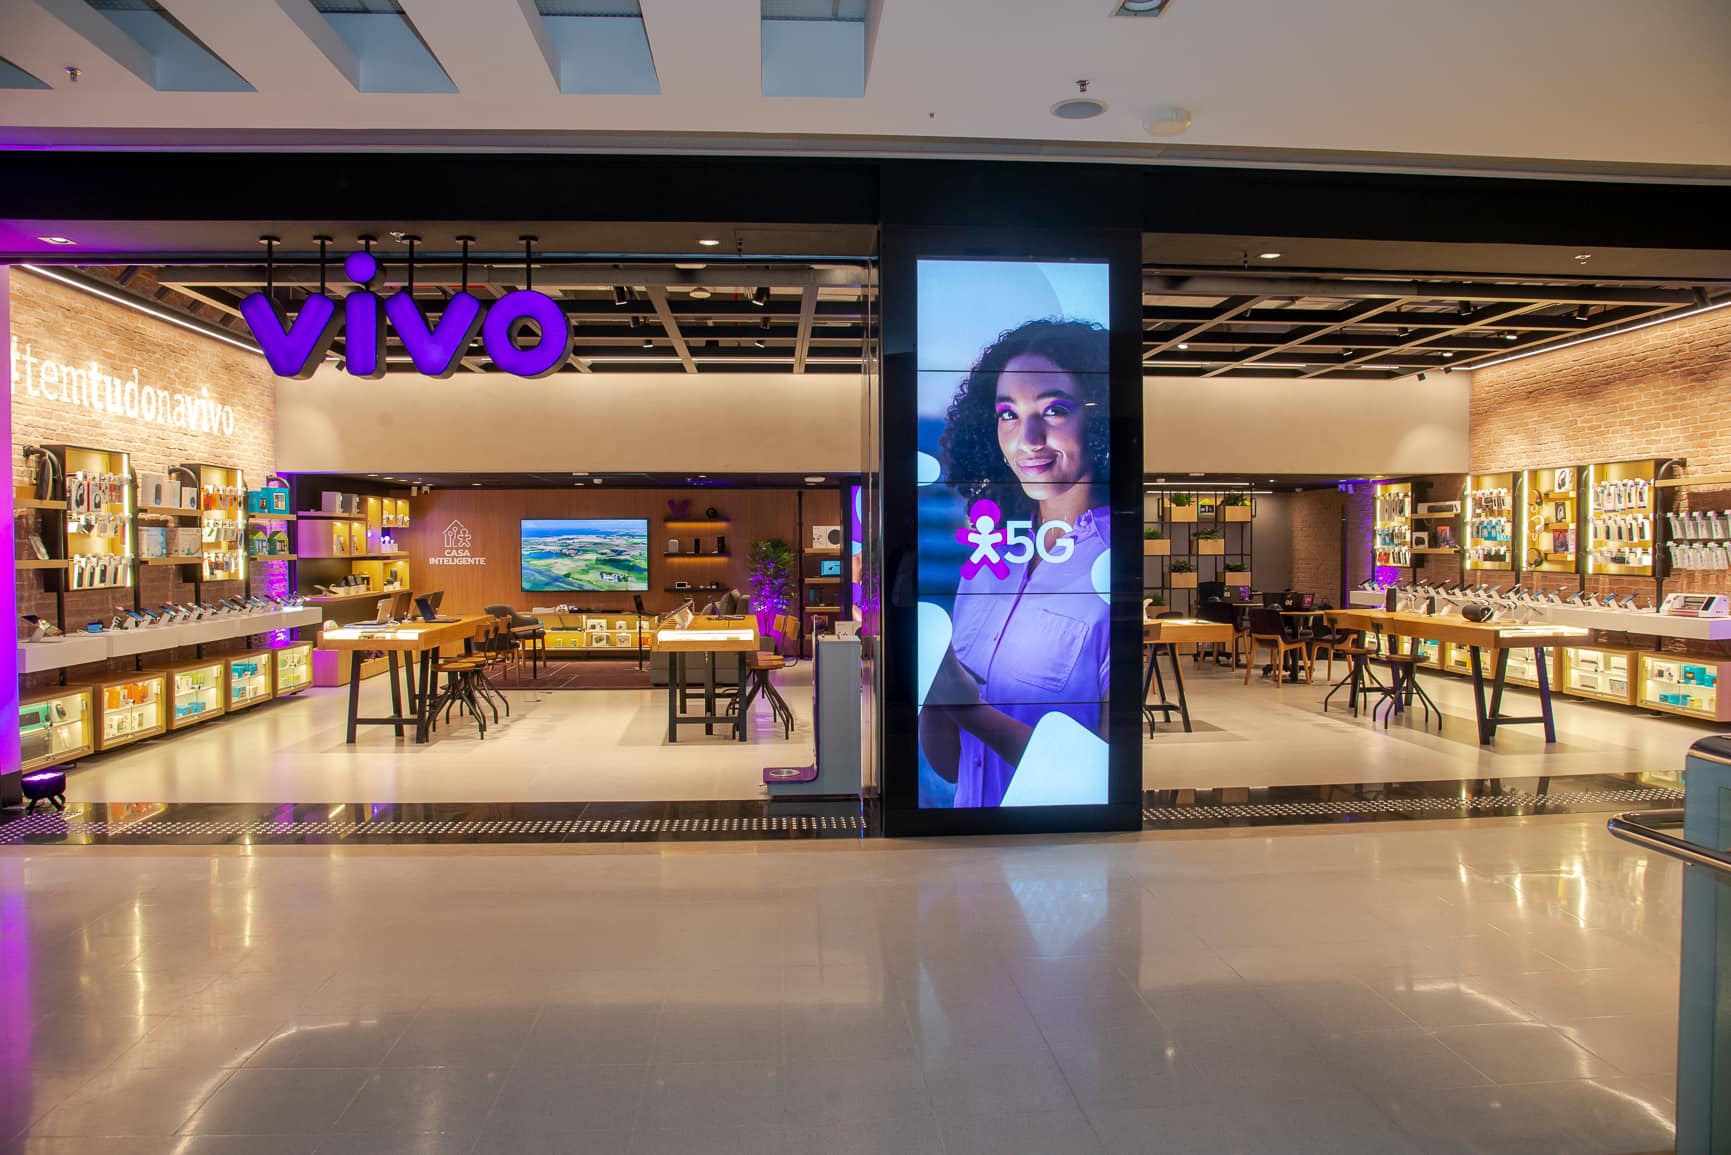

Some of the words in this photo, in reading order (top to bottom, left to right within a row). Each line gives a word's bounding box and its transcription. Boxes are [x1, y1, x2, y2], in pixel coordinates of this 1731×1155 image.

[240, 251, 571, 378] vivo
[444, 549, 471, 557] CASA
[1004, 519, 1075, 564] 5G
[428, 556, 487, 565] INTELIGENTE
